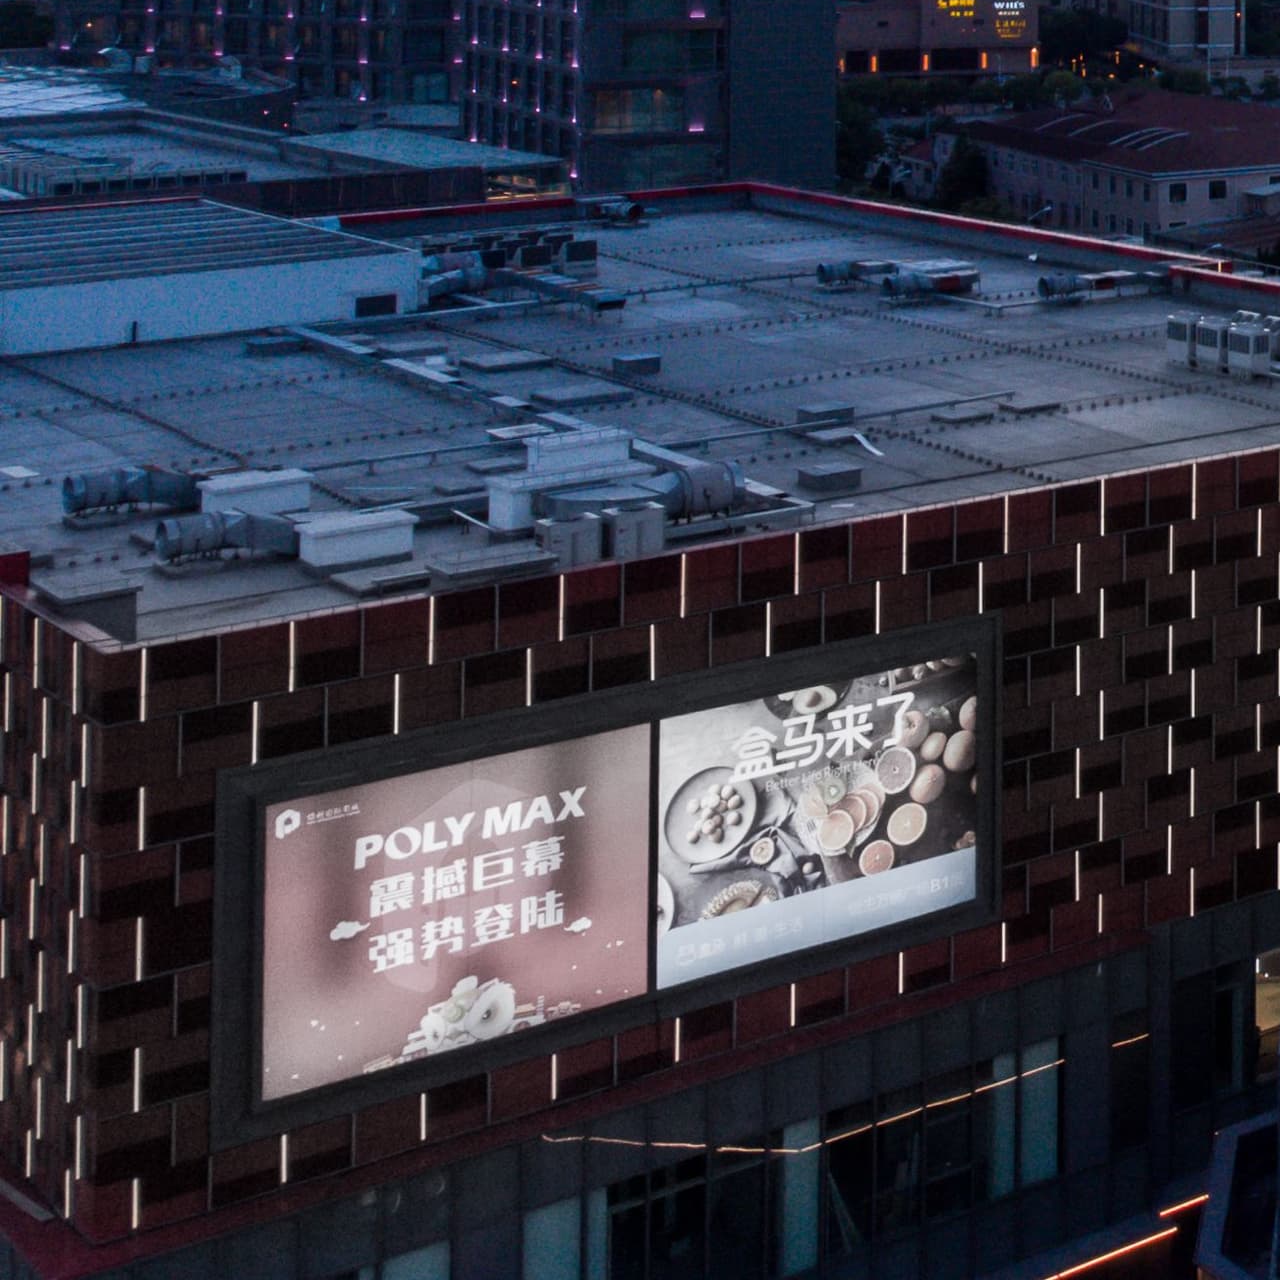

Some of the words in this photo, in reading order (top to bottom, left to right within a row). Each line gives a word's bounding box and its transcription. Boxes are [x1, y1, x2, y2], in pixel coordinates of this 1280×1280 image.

[727, 690, 915, 784] 盒马来了
[354, 811, 476, 870] POLY
[481, 786, 587, 839] MAX
[369, 835, 565, 918] 震撼巨幕
[368, 889, 565, 973] 强势登陆
